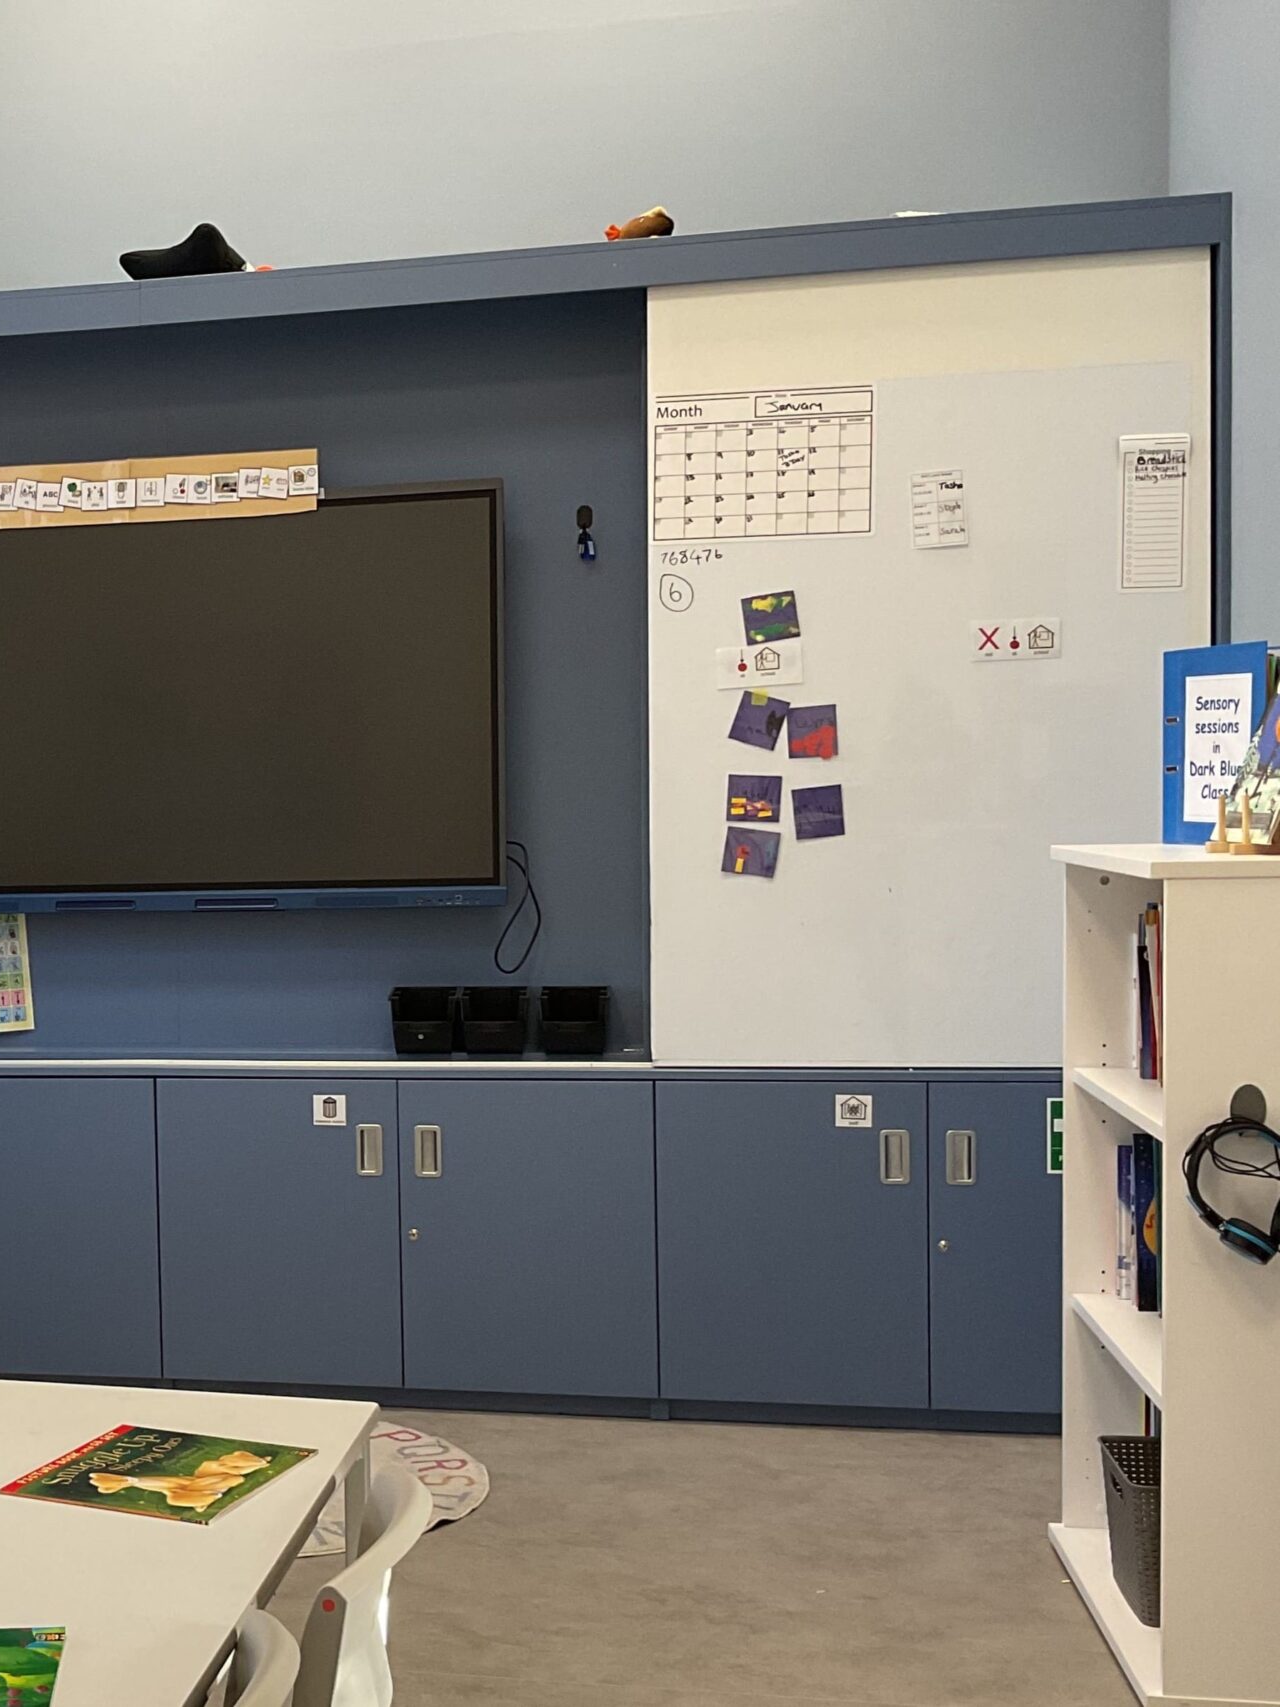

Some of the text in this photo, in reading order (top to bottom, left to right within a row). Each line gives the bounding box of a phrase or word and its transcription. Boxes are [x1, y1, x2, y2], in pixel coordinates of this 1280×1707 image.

[656, 405, 703, 418] Month
[765, 400, 822, 413] January
[670, 582, 682, 603] 6
[1195, 696, 1240, 714] Sensory
[1195, 719, 1239, 735] sessions
[1212, 741, 1221, 754] in
[1189, 761, 1215, 776] Dark
[1201, 785, 1229, 800] Class
[42, 1448, 131, 1485] Snuggle
